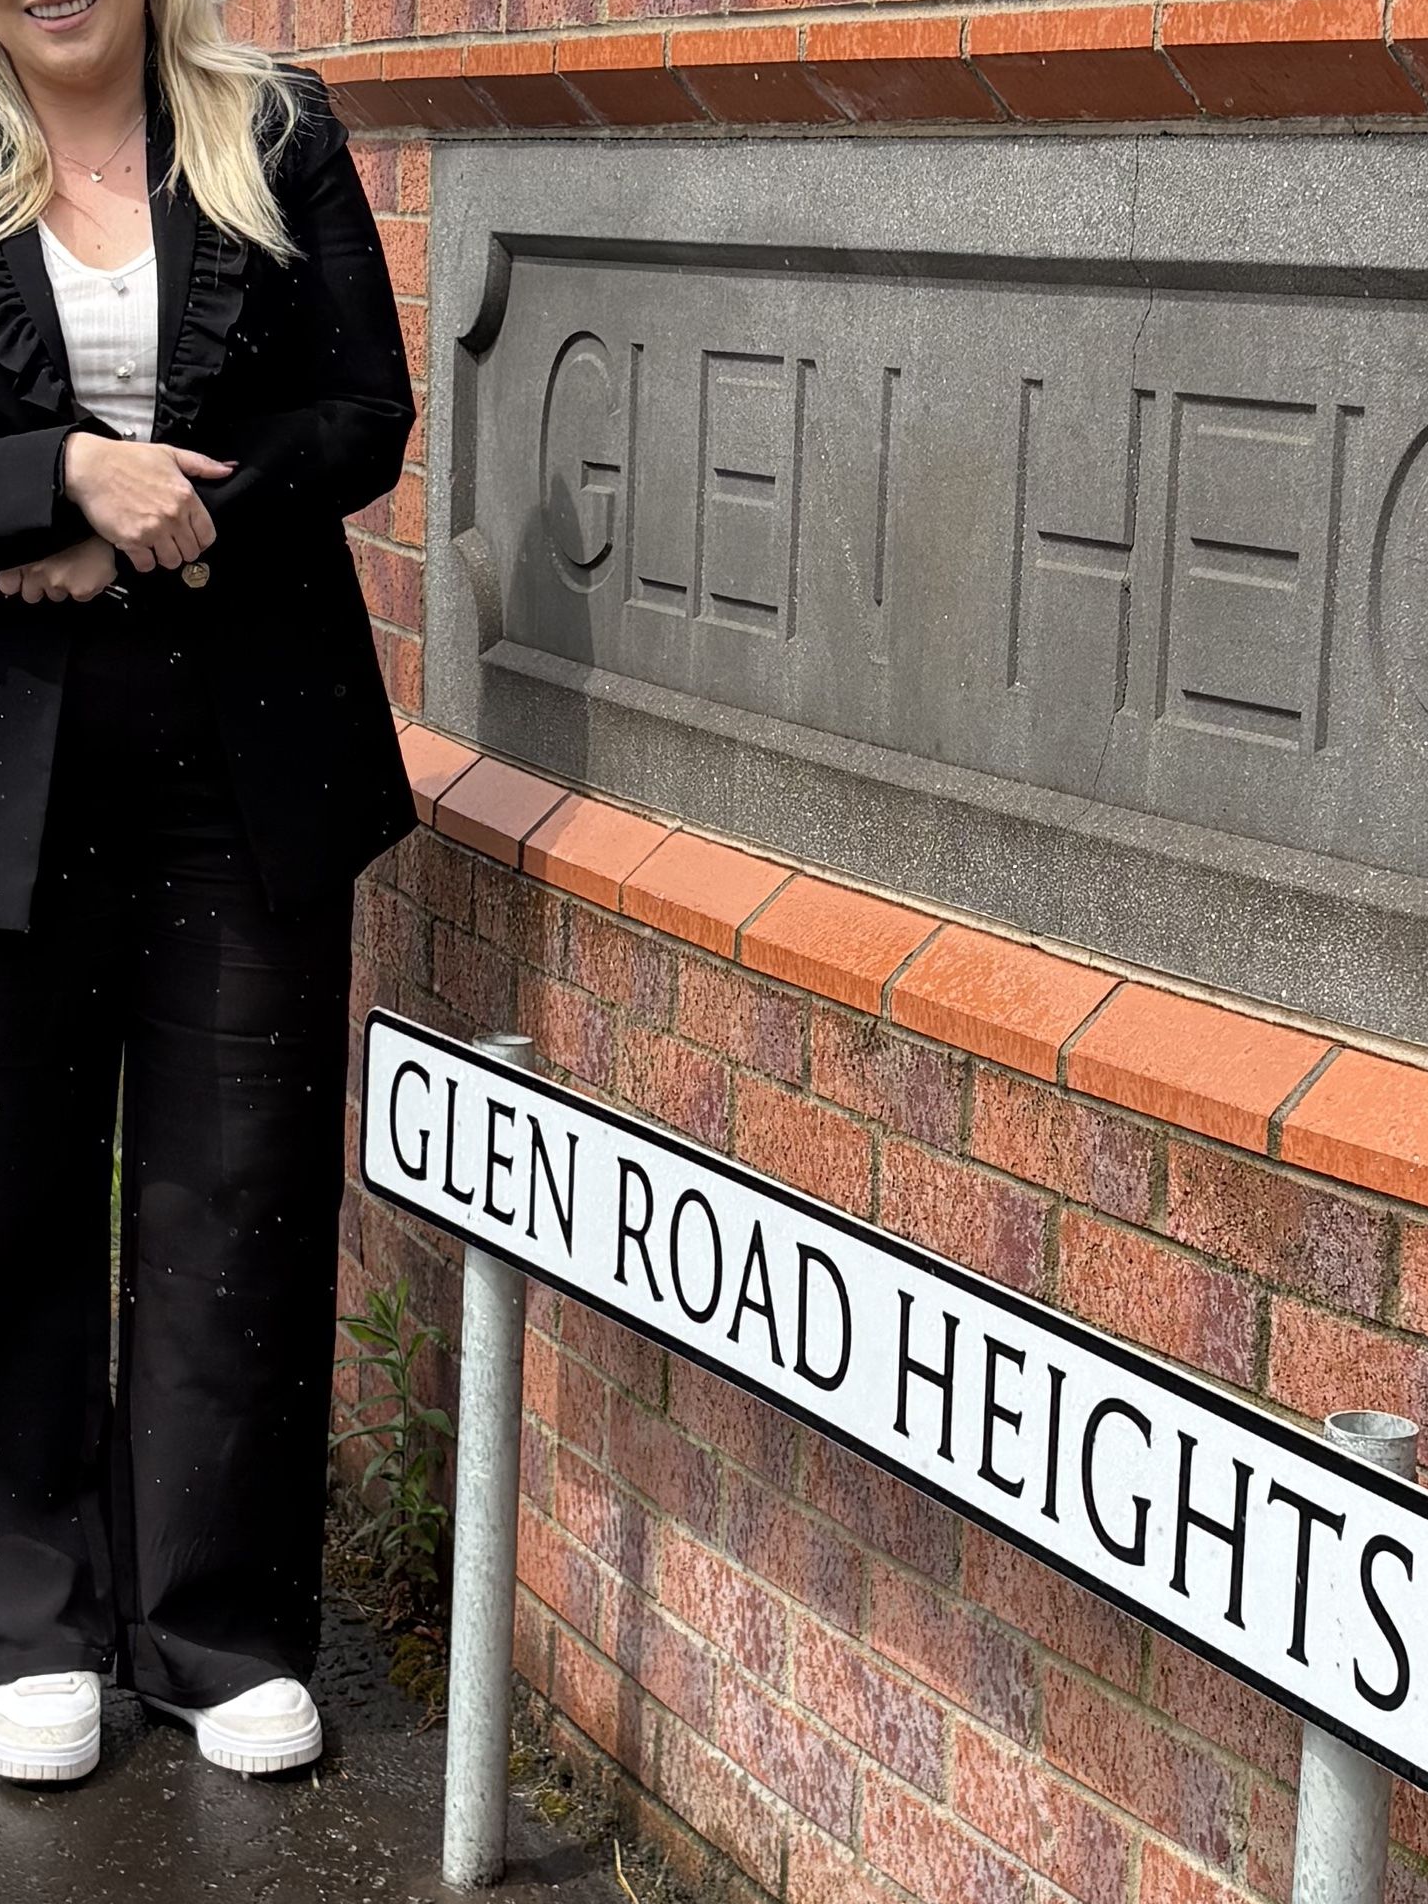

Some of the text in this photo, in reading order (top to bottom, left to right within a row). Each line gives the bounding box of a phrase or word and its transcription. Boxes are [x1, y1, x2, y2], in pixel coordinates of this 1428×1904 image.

[539, 330, 902, 668] GLEN
[388, 1059, 1415, 1713] GLEN ROAD HEIGHTS
